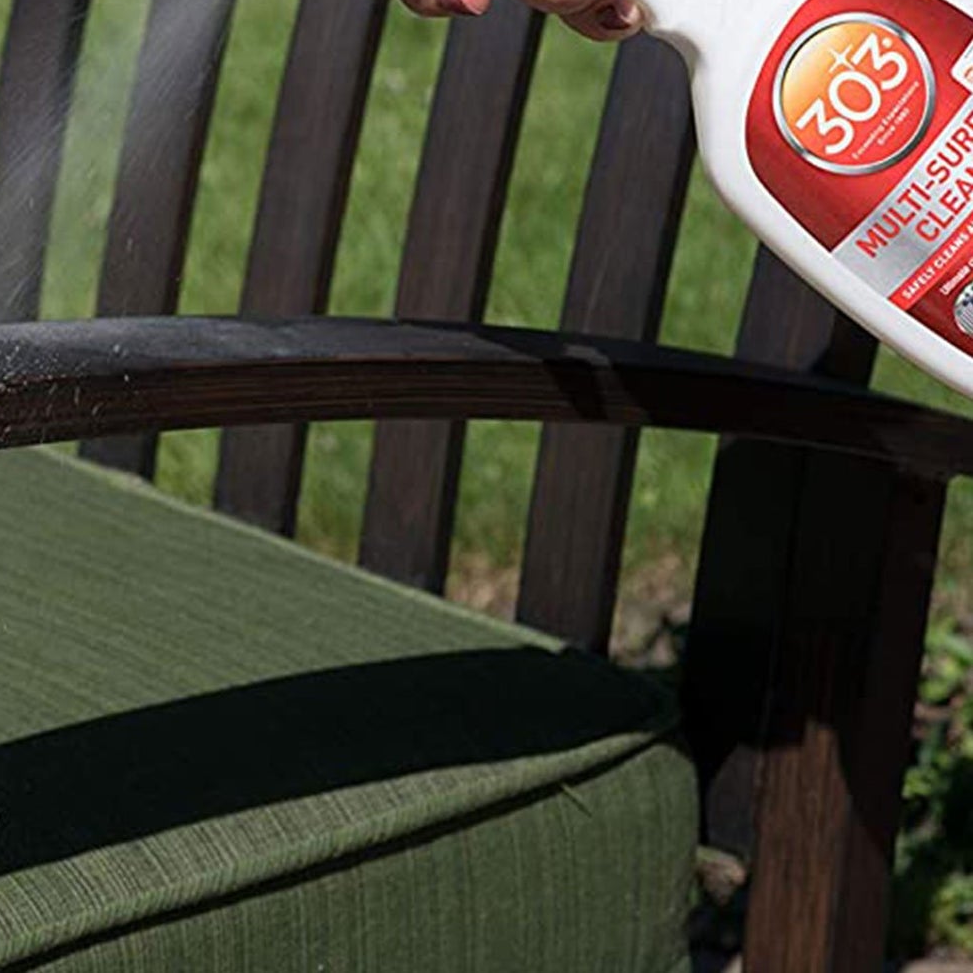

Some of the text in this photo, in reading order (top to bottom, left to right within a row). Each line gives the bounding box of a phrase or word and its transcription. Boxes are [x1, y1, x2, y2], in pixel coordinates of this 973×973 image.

[795, 32, 908, 155] 303
[901, 232, 970, 300] SAFELY CLEANS
